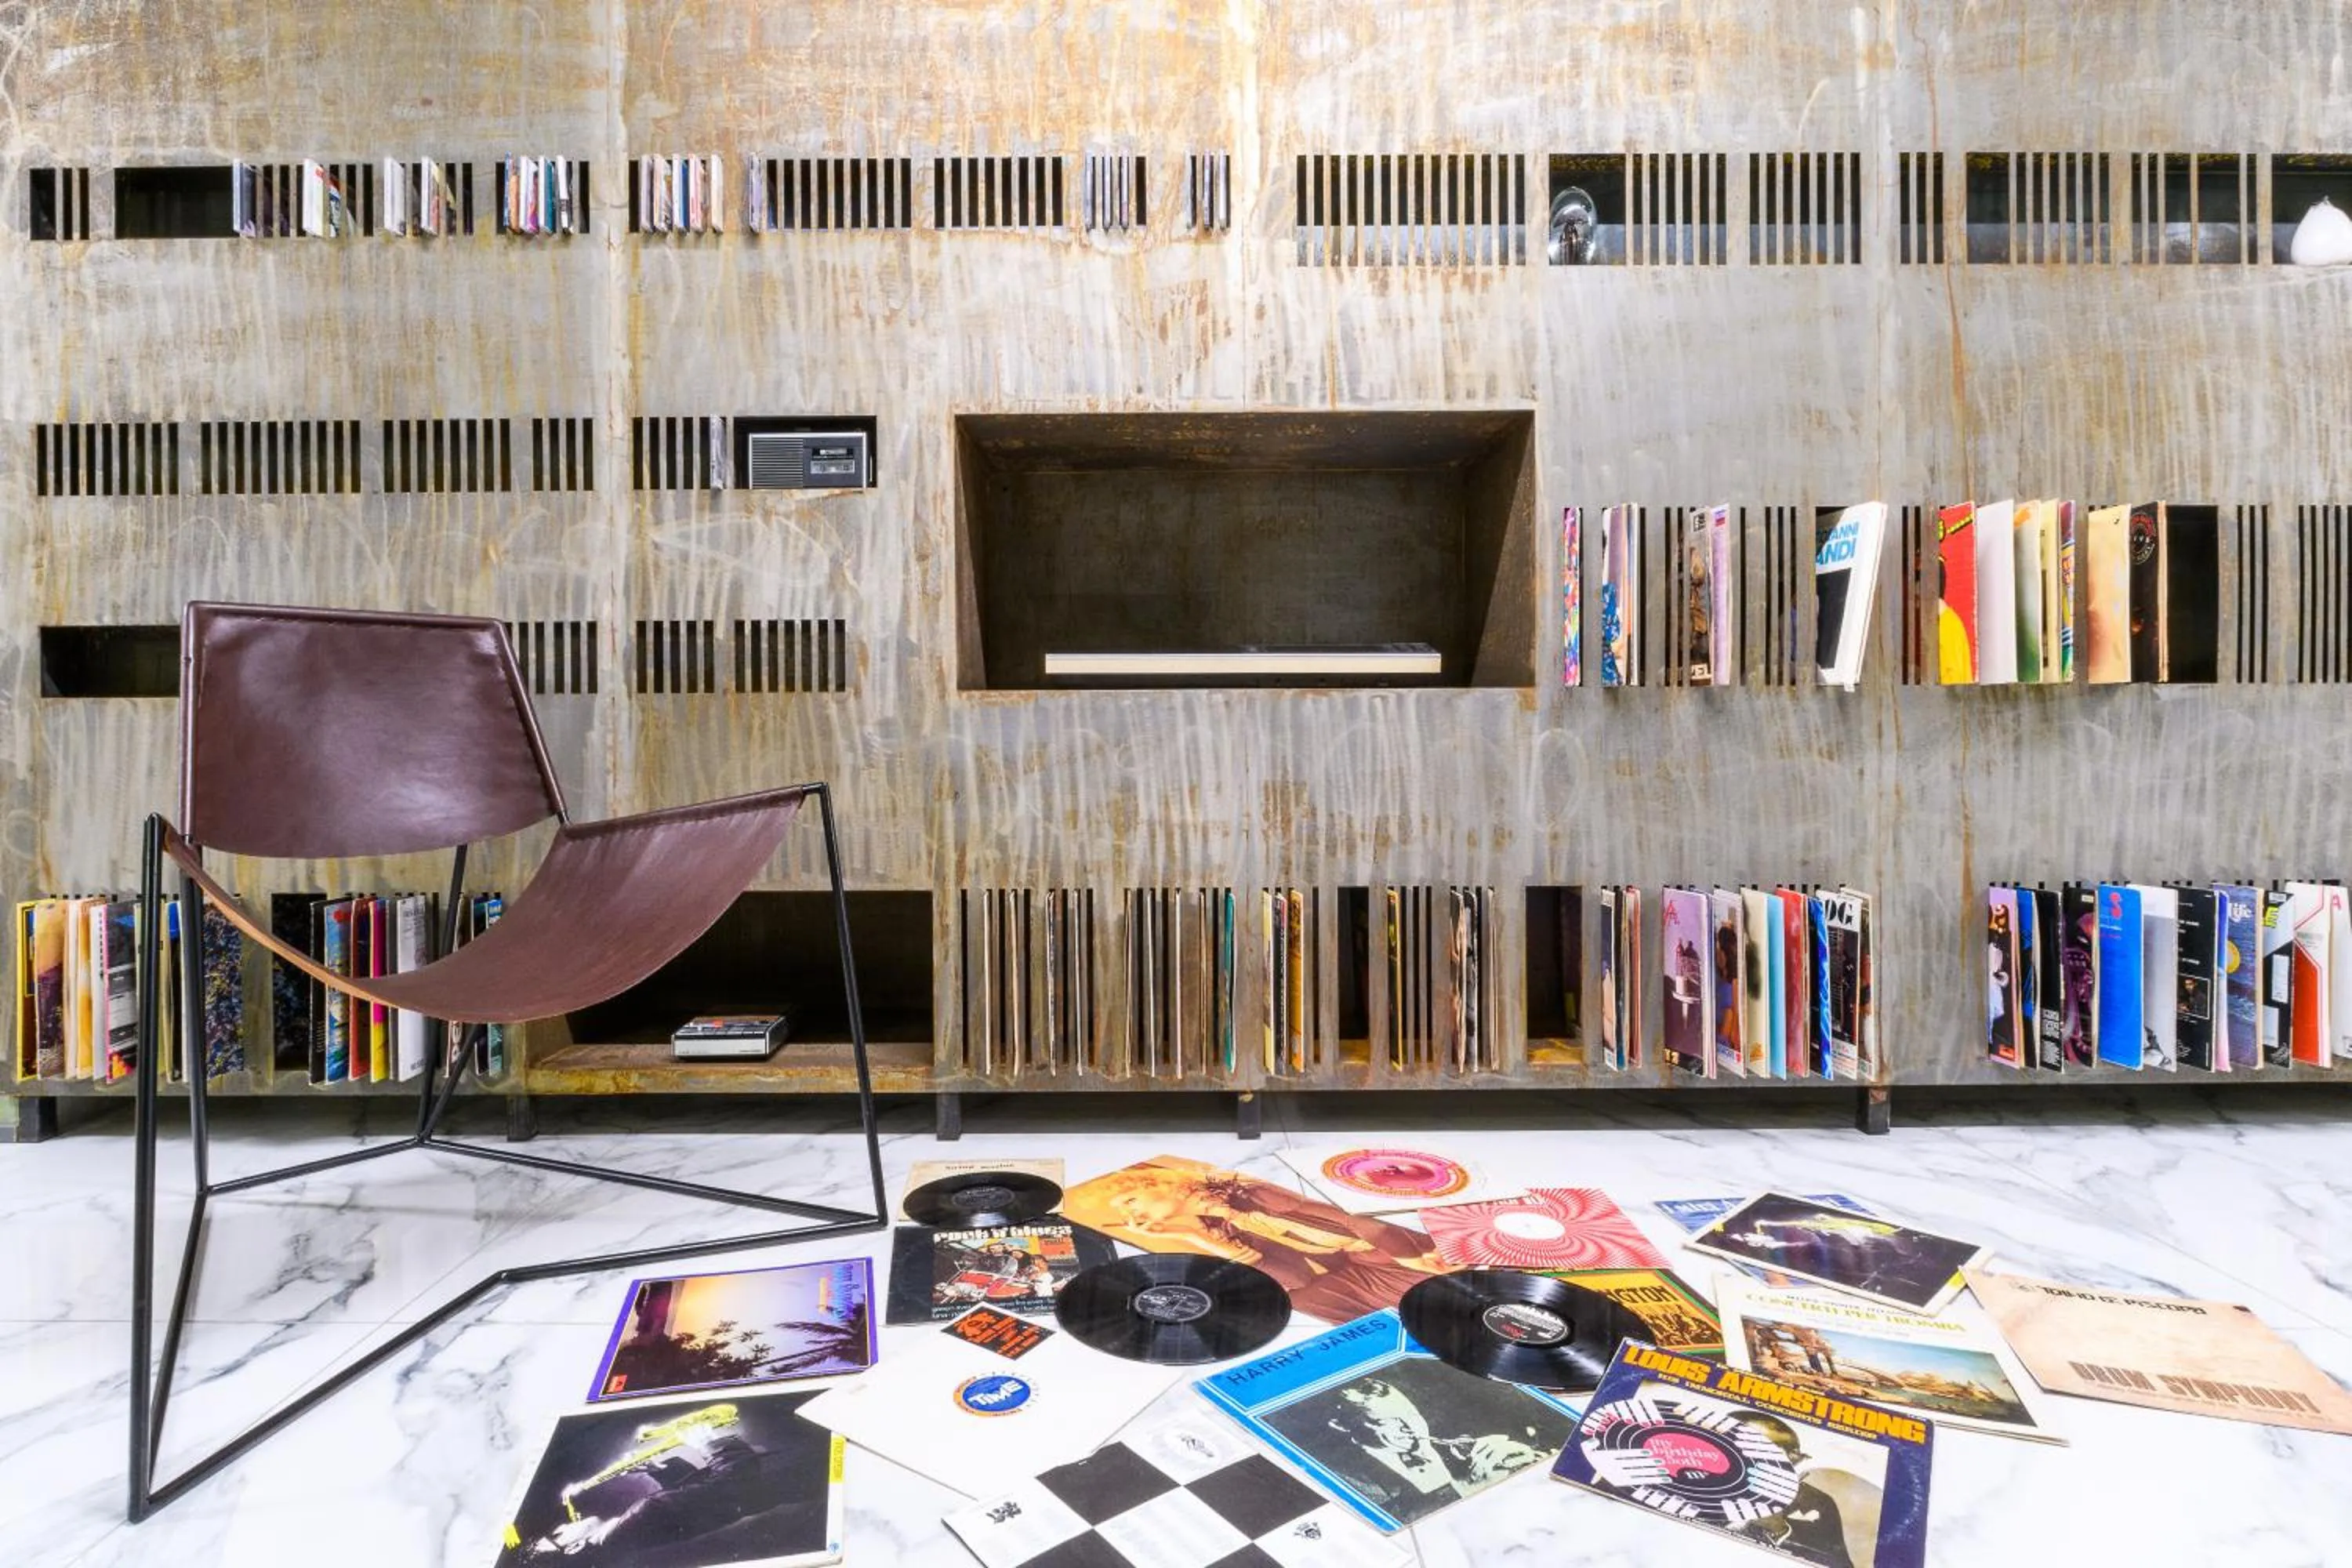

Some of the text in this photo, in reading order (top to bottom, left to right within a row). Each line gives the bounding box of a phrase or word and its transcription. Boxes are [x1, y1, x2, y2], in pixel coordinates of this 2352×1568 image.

[1226, 1319, 1388, 1386] HARRY JAMES
[1623, 1345, 1711, 1385] LOUIS
[1715, 1372, 1927, 1445] ARMSTRONG
[2157, 1374, 2322, 1414] SYMPHONY
